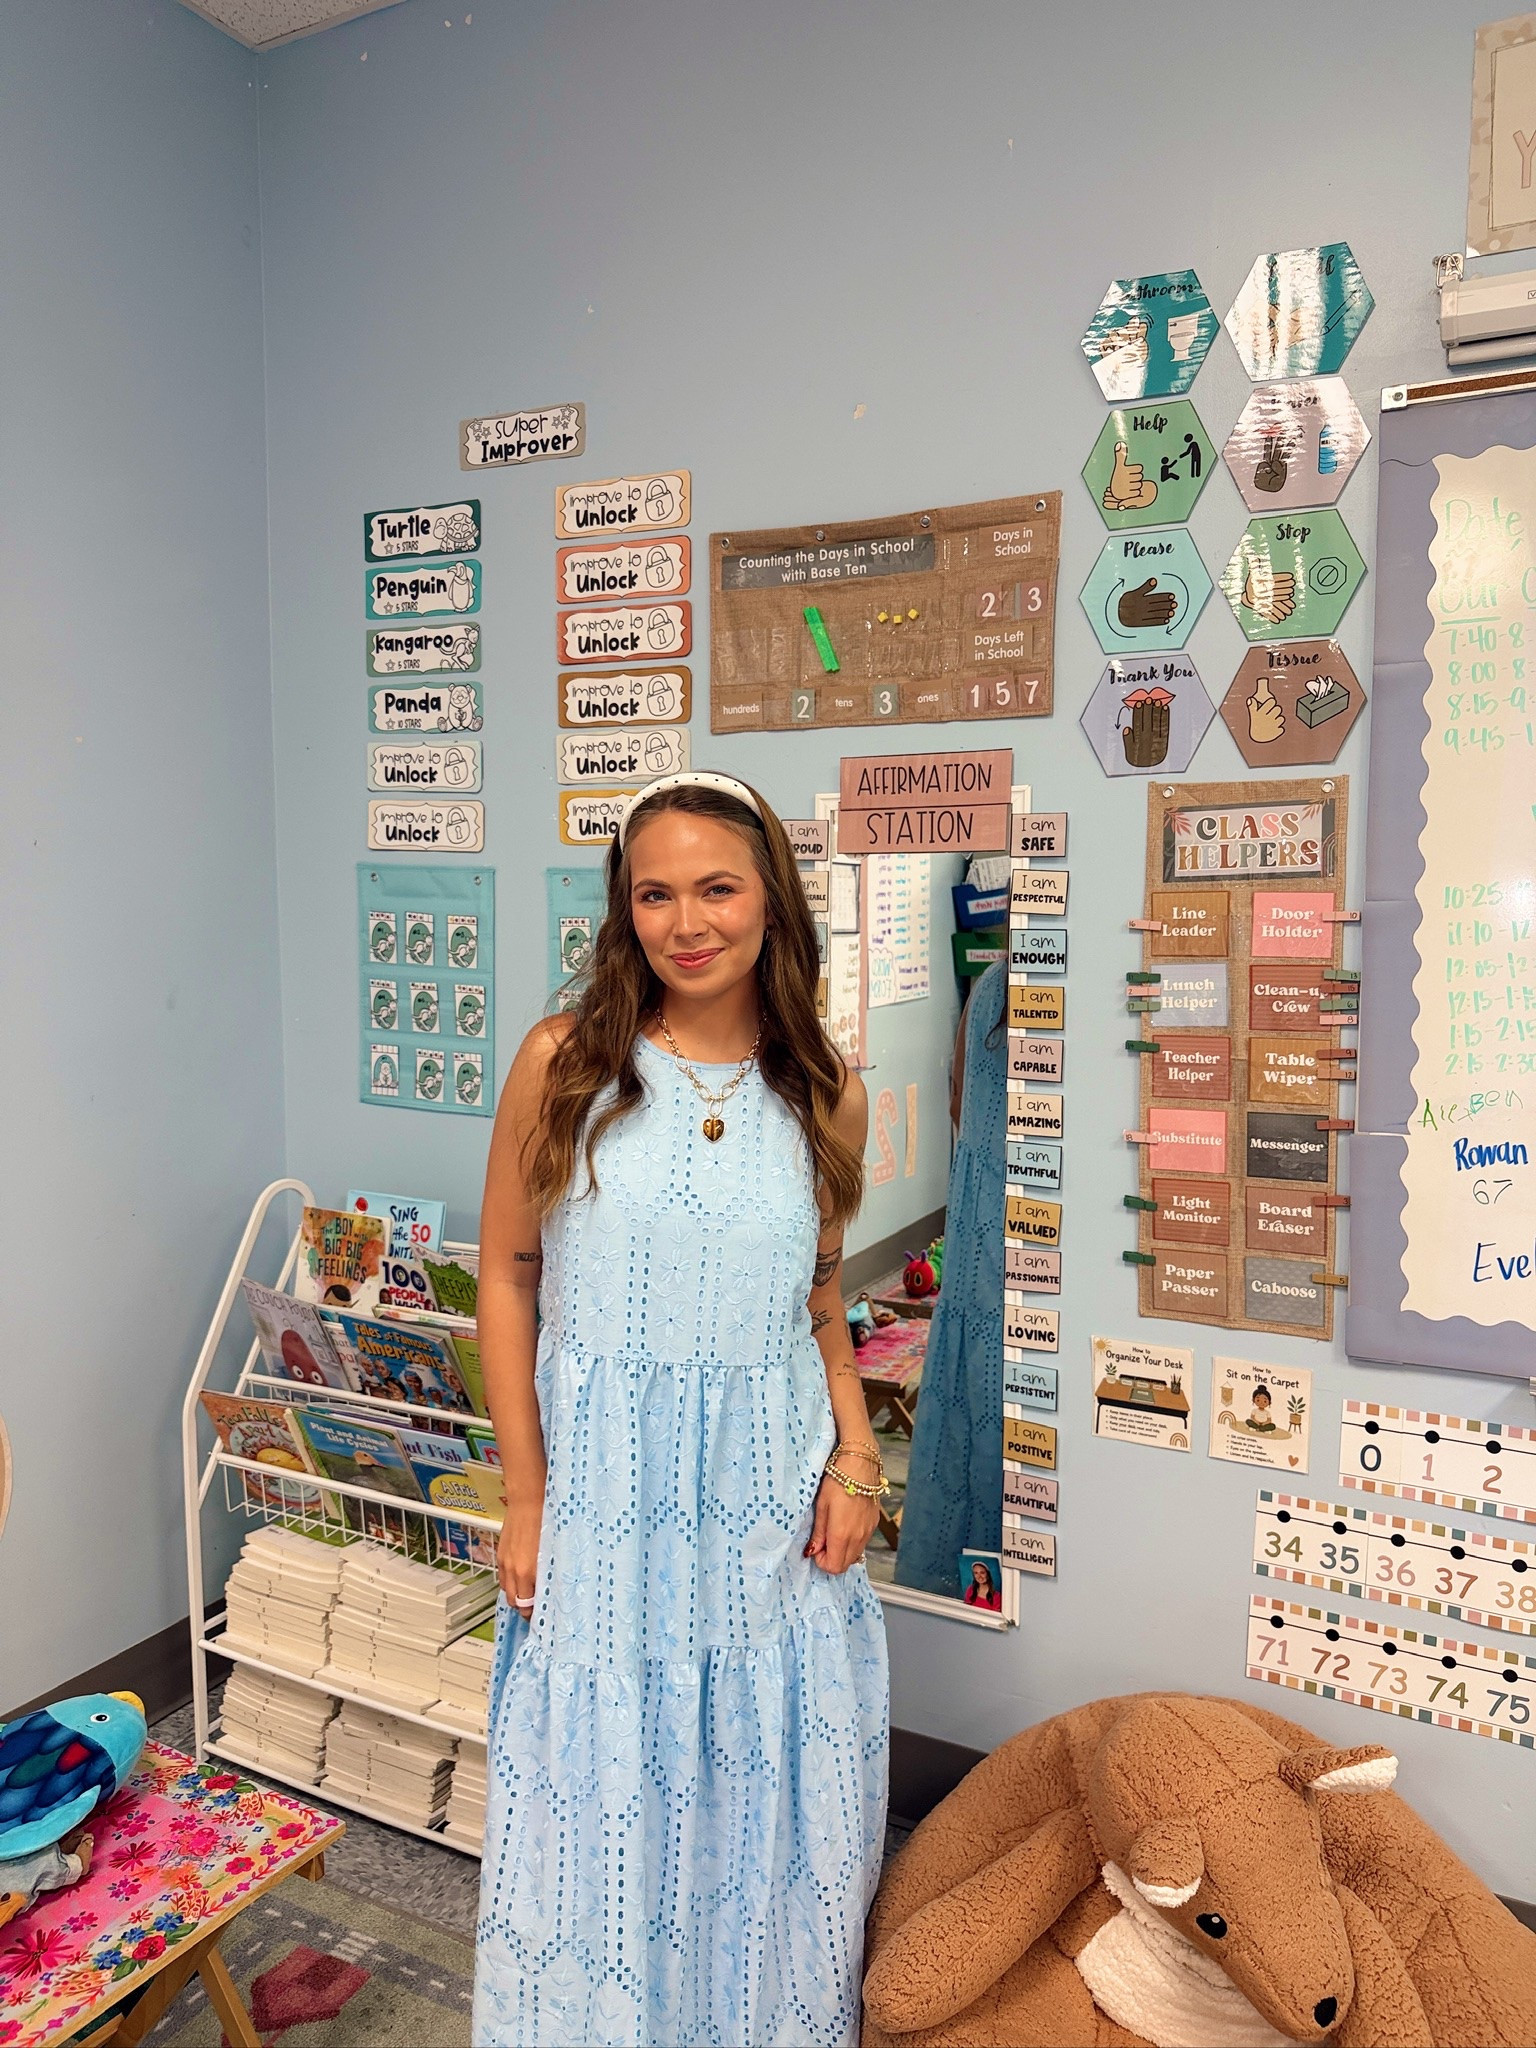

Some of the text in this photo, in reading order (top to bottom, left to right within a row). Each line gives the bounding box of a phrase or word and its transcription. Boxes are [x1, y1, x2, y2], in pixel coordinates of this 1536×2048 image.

[1133, 414, 1168, 433] Help
[481, 432, 574, 462] Improver
[570, 484, 642, 507] improve to
[576, 504, 637, 528] Unlock
[378, 515, 430, 541] Turtle
[993, 527, 1034, 545] Days in
[1276, 524, 1311, 543] Stop
[402, 541, 419, 551] STARS
[739, 538, 915, 571] Counting the Days in School
[995, 542, 1031, 557] School
[1124, 541, 1175, 558] Please
[571, 551, 642, 573] improve to
[576, 571, 638, 593] Unlock
[781, 563, 867, 583] with Base Ten
[377, 577, 447, 602] Penguin
[981, 587, 1042, 618] 2 3
[375, 634, 453, 655] Kangaroo
[578, 633, 639, 653] Unlock
[974, 630, 1025, 647] Days Left
[974, 646, 1024, 661] in School
[1267, 652, 1321, 669] Tissue
[1163, 663, 1195, 681] You
[385, 693, 441, 714] Panda
[797, 695, 810, 719] 2
[835, 698, 853, 709] tens
[879, 690, 893, 715] 3
[917, 693, 939, 704] ones
[578, 698, 639, 718] Unlock
[723, 704, 760, 716] hundreds
[405, 719, 422, 729] STARS
[380, 749, 441, 766] improve to
[576, 755, 637, 775] Unlock
[384, 766, 437, 784] Unlock
[857, 763, 992, 796] AFFIRMATION
[867, 811, 973, 845] STATION
[1021, 817, 1056, 831] I am
[1195, 812, 1300, 841] CLASS
[386, 825, 440, 843] Unlock
[1021, 837, 1055, 851] SAFE
[1177, 839, 1320, 872] HELPERS
[1013, 893, 1065, 904] RESPECTFUL
[1172, 906, 1207, 920] Line
[1271, 907, 1315, 921] Door
[1162, 924, 1217, 937] Leader
[1261, 924, 1323, 939] Holder
[1020, 934, 1056, 948] I am
[1012, 952, 1065, 965] ENOUGH
[1163, 978, 1216, 991] Lunch
[1253, 983, 1330, 1000] Clean-up
[1161, 996, 1217, 1013] Helper
[1271, 1000, 1311, 1013] Crew
[1013, 1008, 1059, 1020] TALENTED
[1162, 1050, 1220, 1064] Teacher
[1265, 1052, 1316, 1067] Table
[1013, 1061, 1057, 1074] CAPABLE
[1168, 1068, 1214, 1083] Helper
[1263, 1071, 1317, 1087] Wiper
[1008, 1116, 1061, 1129] AMAZING
[1153, 1131, 1223, 1146] Substitute
[1250, 1138, 1324, 1154] Messenger
[1453, 1137, 1529, 1172] Rowan
[1007, 1164, 1058, 1179] TRUTHFUL
[1473, 1179, 1513, 1205] 67
[1172, 1196, 1211, 1210] Light
[1259, 1202, 1312, 1218] Board
[390, 1205, 419, 1222] SING
[1162, 1210, 1221, 1225] Monitor
[335, 1217, 354, 1236] BOY
[393, 1223, 431, 1243] the 50
[1008, 1219, 1057, 1239] VALUED
[1257, 1219, 1314, 1236] Eraser
[346, 1240, 363, 1260] BIG
[318, 1258, 367, 1284] FEELINGS
[382, 1261, 427, 1292] 100
[1005, 1271, 1059, 1284] PASSIONATE
[1165, 1263, 1215, 1281] Paper
[388, 1286, 425, 1304] PEOPLE
[1162, 1280, 1218, 1298] Passer
[1251, 1280, 1317, 1299] Caboose
[352, 1321, 435, 1352] Tales of Famous
[1008, 1325, 1056, 1343] LOVING
[357, 1336, 447, 1371] Americans
[1106, 1350, 1184, 1370] Organize Your Desk
[1252, 1366, 1264, 1374] How
[1226, 1369, 1300, 1390] Sit on the Carpet
[1005, 1383, 1056, 1400] PERSISTENT
[310, 1421, 389, 1448] Plant and Animal
[326, 1432, 380, 1452] Life Cycles
[426, 1443, 462, 1462] Fish
[1008, 1441, 1053, 1461] POSITIVE
[1360, 1444, 1503, 1494] 0 1 2
[441, 1481, 479, 1498] A Frie
[435, 1493, 487, 1512] Someone
[1004, 1493, 1057, 1512] BEAUTIFUL
[1003, 1548, 1054, 1566] INTELLIGENT
[1264, 1531, 1536, 1614] 34 35 36 37 38
[1256, 1634, 1531, 1724] 71 72 73 74 75
